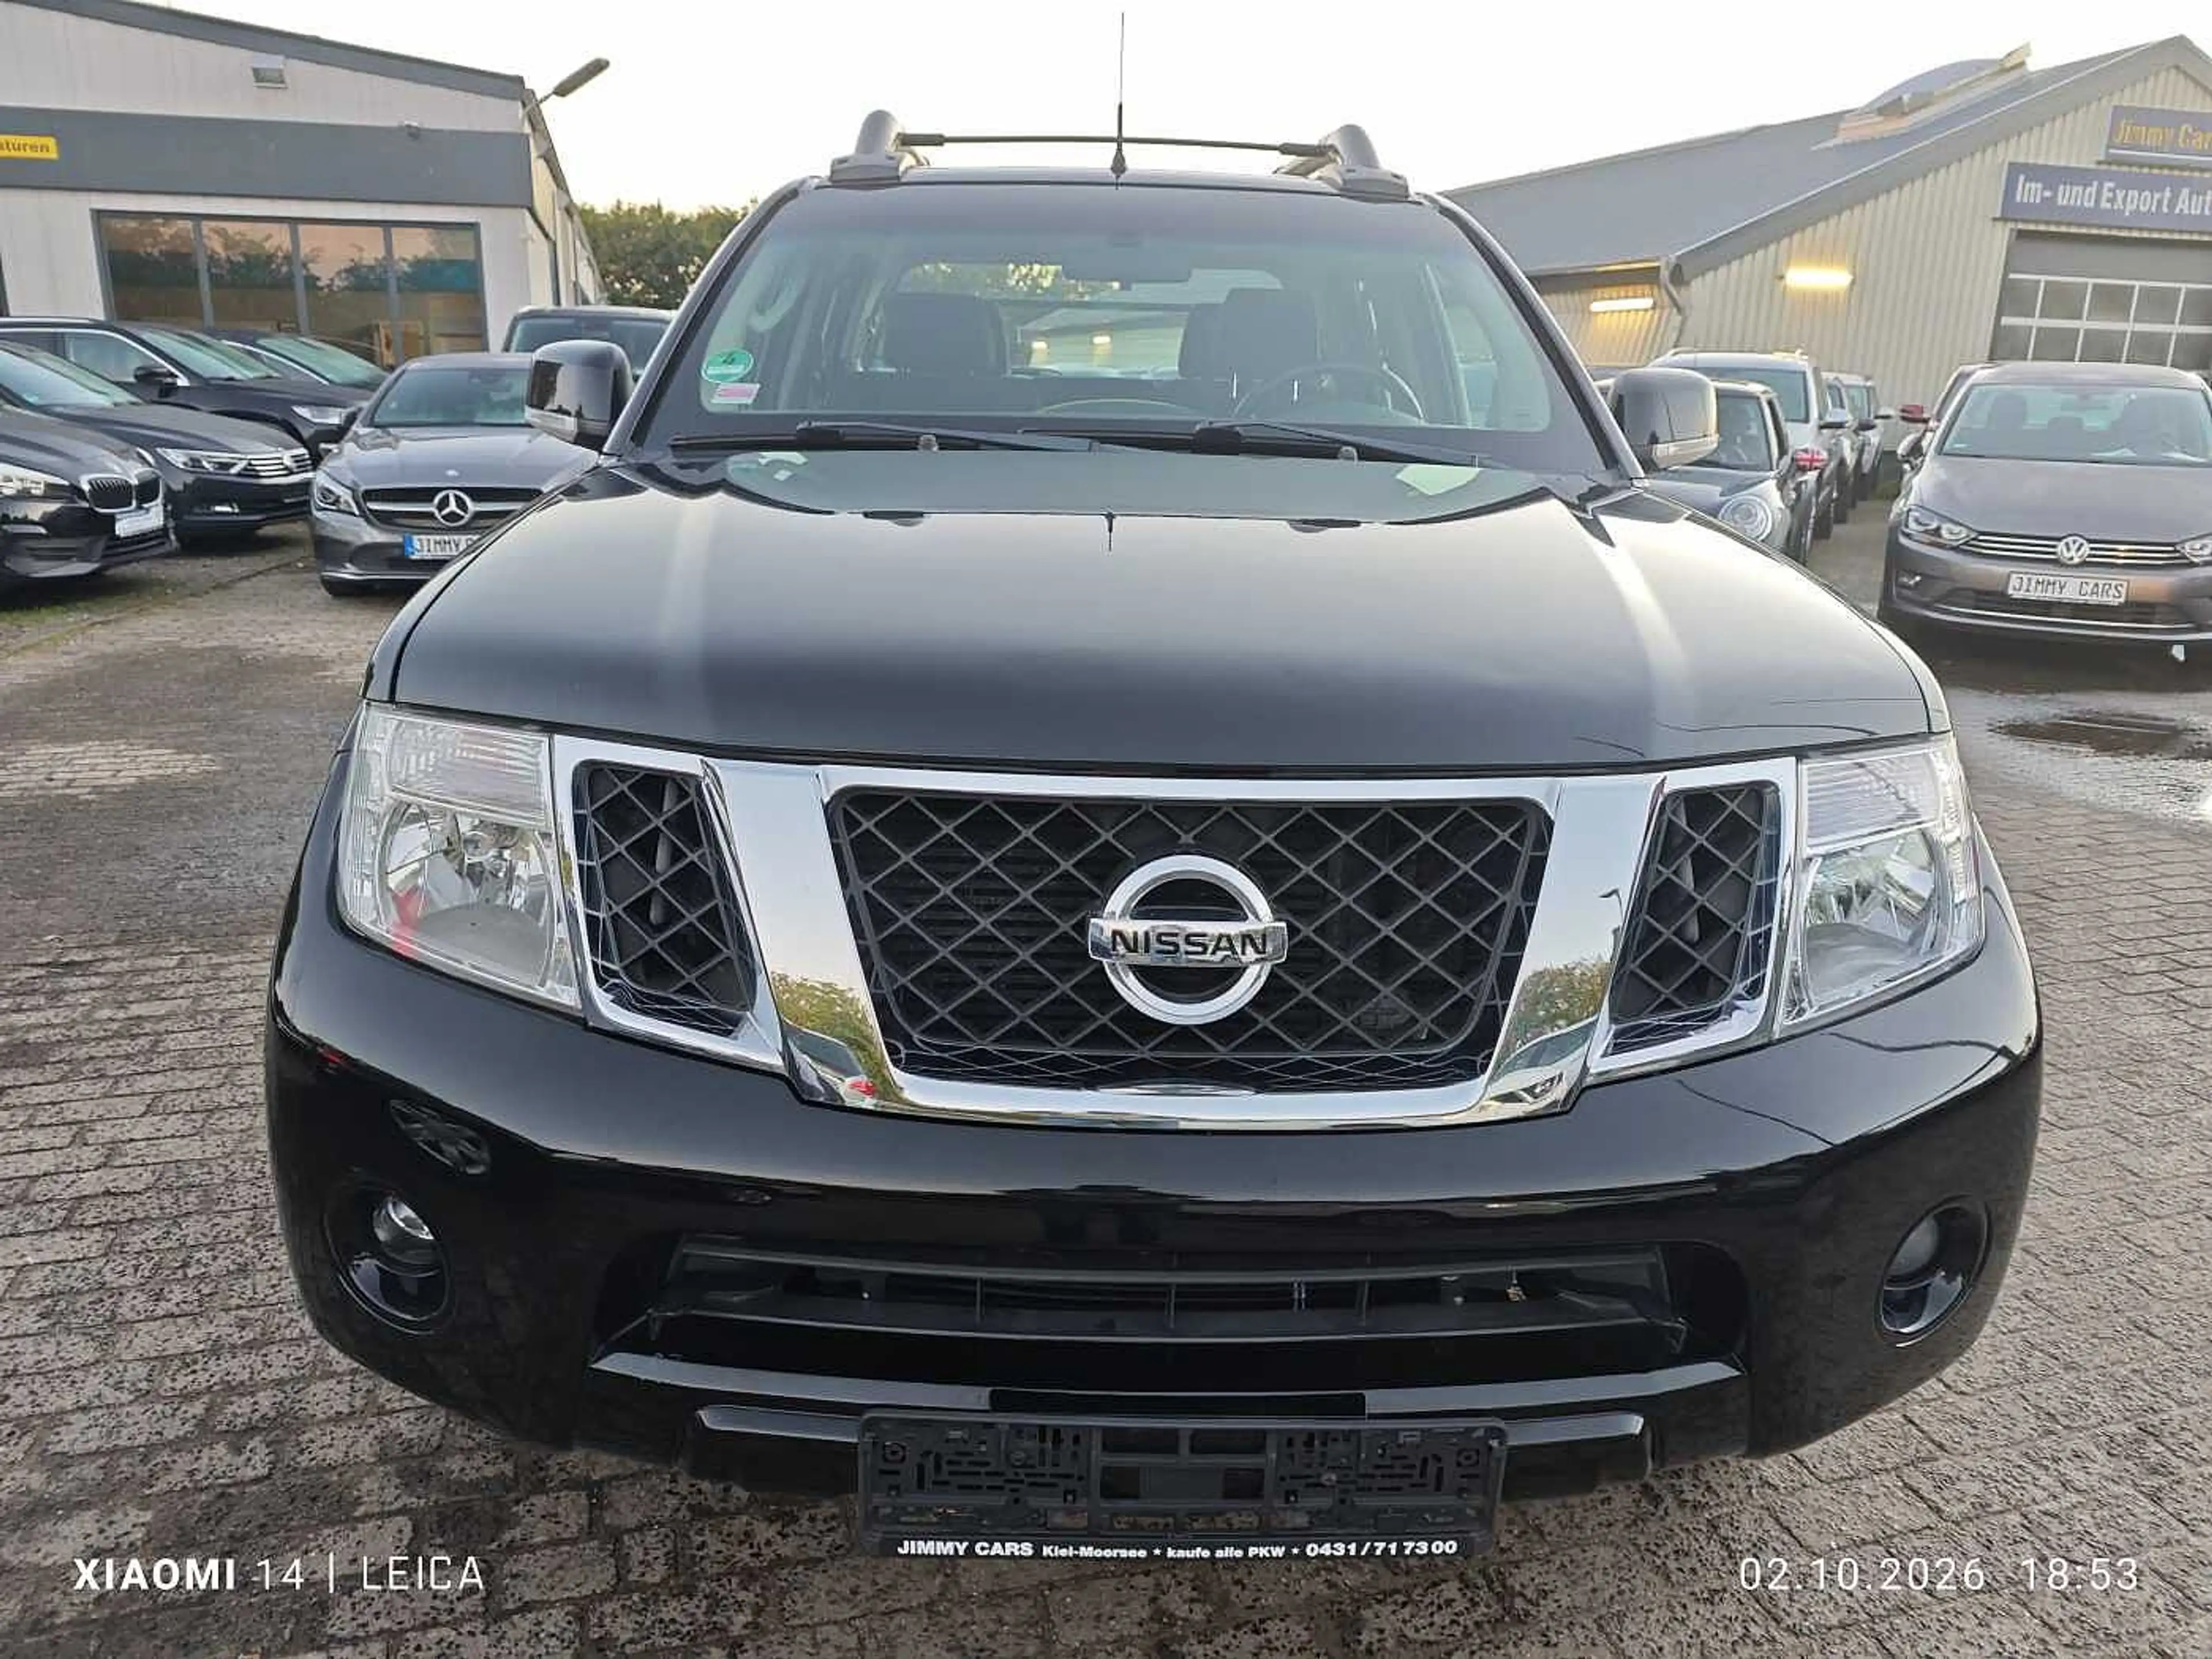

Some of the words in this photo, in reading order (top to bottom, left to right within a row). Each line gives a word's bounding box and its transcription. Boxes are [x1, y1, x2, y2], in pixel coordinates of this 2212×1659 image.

[2112, 120, 2176, 148] Jimmy
[2016, 174, 2052, 203] Im-
[2056, 180, 2097, 209] und
[2100, 181, 2171, 215] Export
[2013, 576, 2067, 594] JIMMY
[2079, 580, 2123, 599] CARS
[1111, 929, 1267, 955] NISSAN
[897, 1540, 969, 1555] JIMMY
[975, 1541, 1034, 1556] CARS
[1166, 1546, 1211, 1558] kaufe
[1214, 1546, 1244, 1558] alle
[1248, 1546, 1286, 1558] PKW
